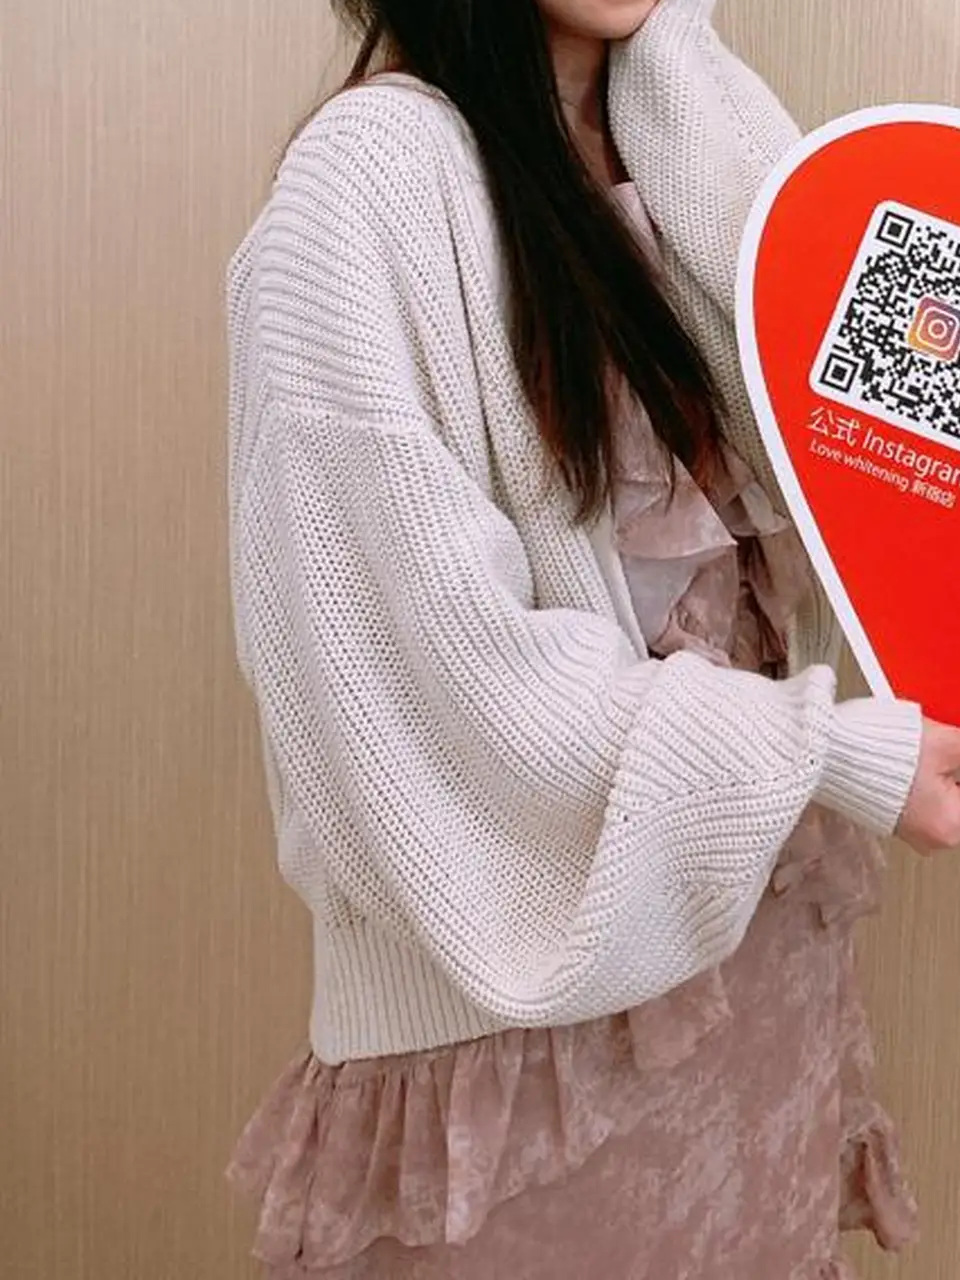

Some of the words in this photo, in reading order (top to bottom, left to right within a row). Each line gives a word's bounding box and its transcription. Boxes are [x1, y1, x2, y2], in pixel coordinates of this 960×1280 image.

[808, 406, 861, 447] 公式
[809, 438, 843, 460] Love
[844, 455, 909, 491] whitening
